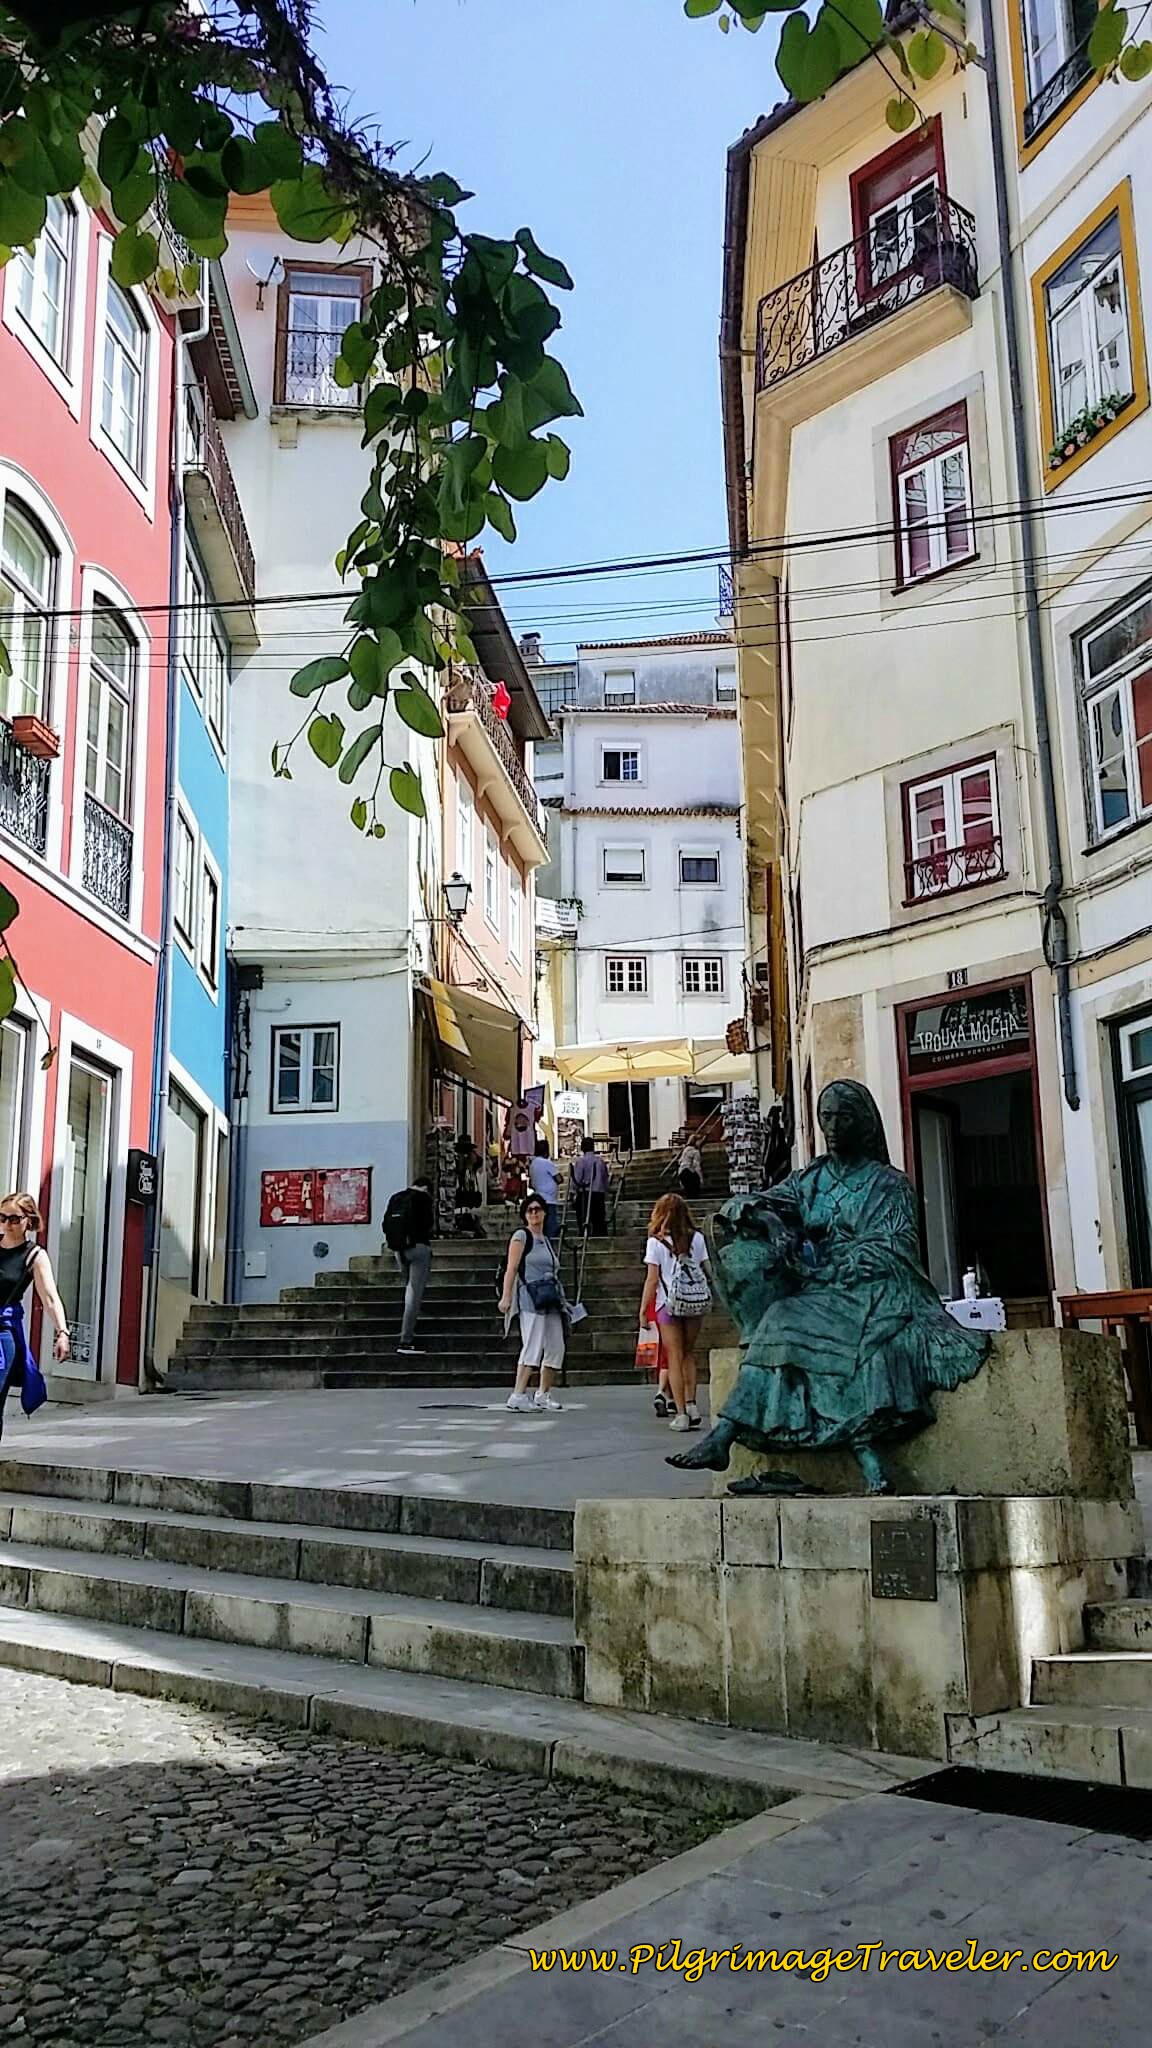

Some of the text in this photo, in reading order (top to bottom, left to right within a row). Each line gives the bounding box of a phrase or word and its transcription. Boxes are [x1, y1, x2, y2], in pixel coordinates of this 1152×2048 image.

[950, 970, 965, 988] 18
[917, 1011, 1020, 1052] TROUXA MOCHA
